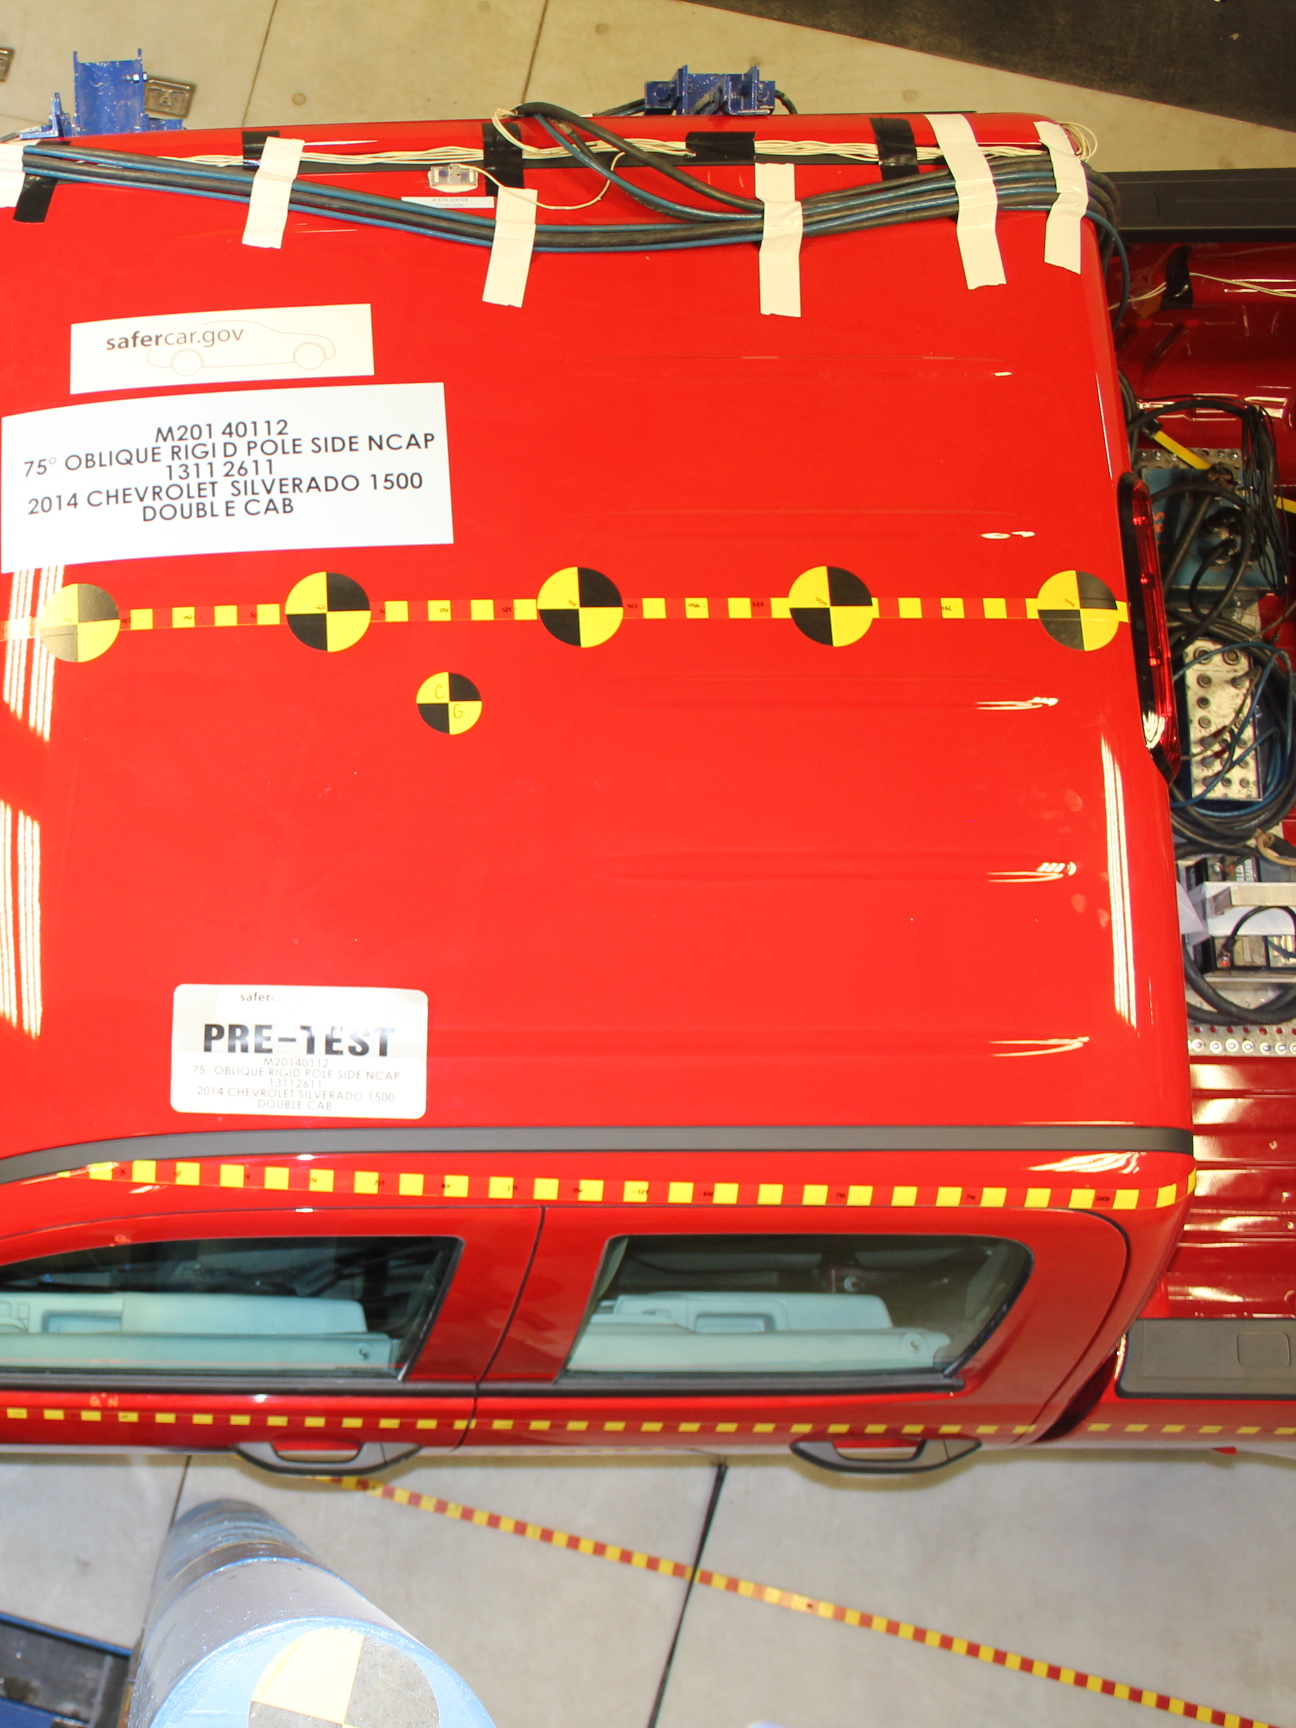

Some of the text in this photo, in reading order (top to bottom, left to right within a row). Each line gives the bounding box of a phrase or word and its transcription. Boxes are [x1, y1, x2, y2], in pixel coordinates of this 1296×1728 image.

[106, 329, 244, 350] safercar.gov
[155, 419, 289, 444] M20140112
[65, 446, 162, 471] OBLIQUE
[171, 442, 237, 462] RIGID
[247, 438, 302, 456] POLE
[311, 436, 359, 454] SIDE
[368, 433, 435, 450] NCAP
[166, 459, 273, 481] 13112611
[28, 472, 423, 515] 2014 CHEVROLET SILVERADO 1500
[143, 497, 294, 522] DOUBLE CAB
[204, 1023, 395, 1057] PRE-TEST
[215, 1065, 264, 1076] OBLIQUE
[269, 1067, 301, 1078] RIGID
[305, 1069, 333, 1079] POLE
[338, 1070, 362, 1080] SIDE
[366, 1071, 400, 1080] NCAP
[263, 1057, 329, 1068] M20140112
[270, 1078, 322, 1088] 13112611
[197, 1086, 395, 1102] 2014 CHEVROLET SILVERADO 1500
[258, 1099, 332, 1110] DOUBLE CAB
